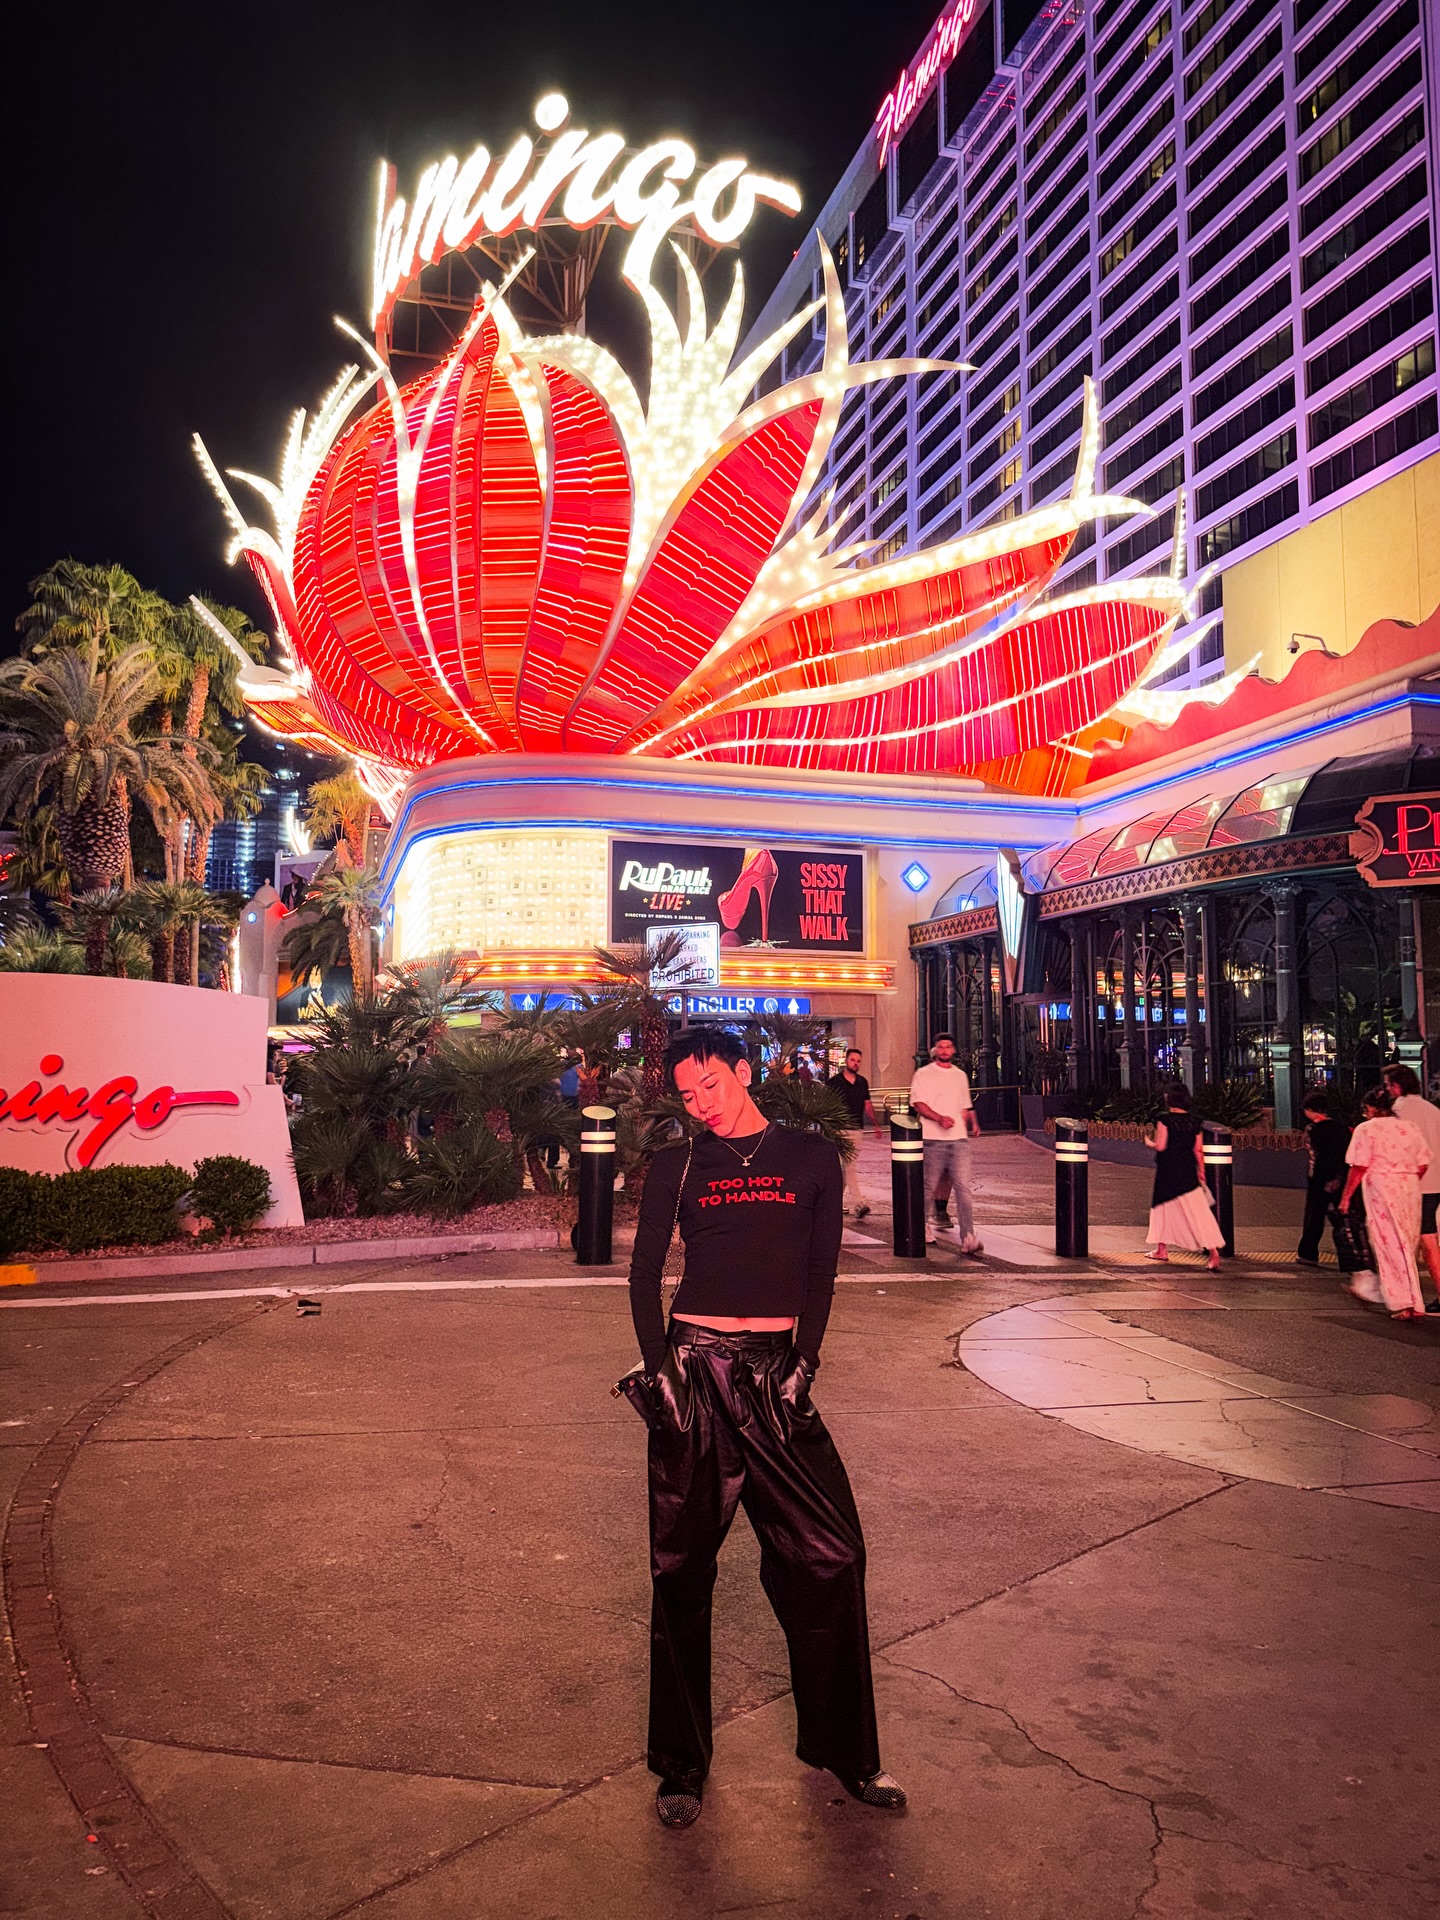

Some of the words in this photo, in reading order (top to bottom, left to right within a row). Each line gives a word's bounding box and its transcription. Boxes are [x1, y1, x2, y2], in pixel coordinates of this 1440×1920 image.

[800, 862, 848, 889] SISSY
[649, 893, 685, 911] LIVE
[802, 888, 846, 914] THAT
[799, 914, 849, 941] WALK
[652, 967, 715, 983] PROHIBITED
[698, 997, 756, 1014] ROLLER
[707, 1178, 745, 1192] TOO
[748, 1176, 785, 1188] HOT
[698, 1195, 722, 1208] TO
[725, 1190, 796, 1204] HANDLE
